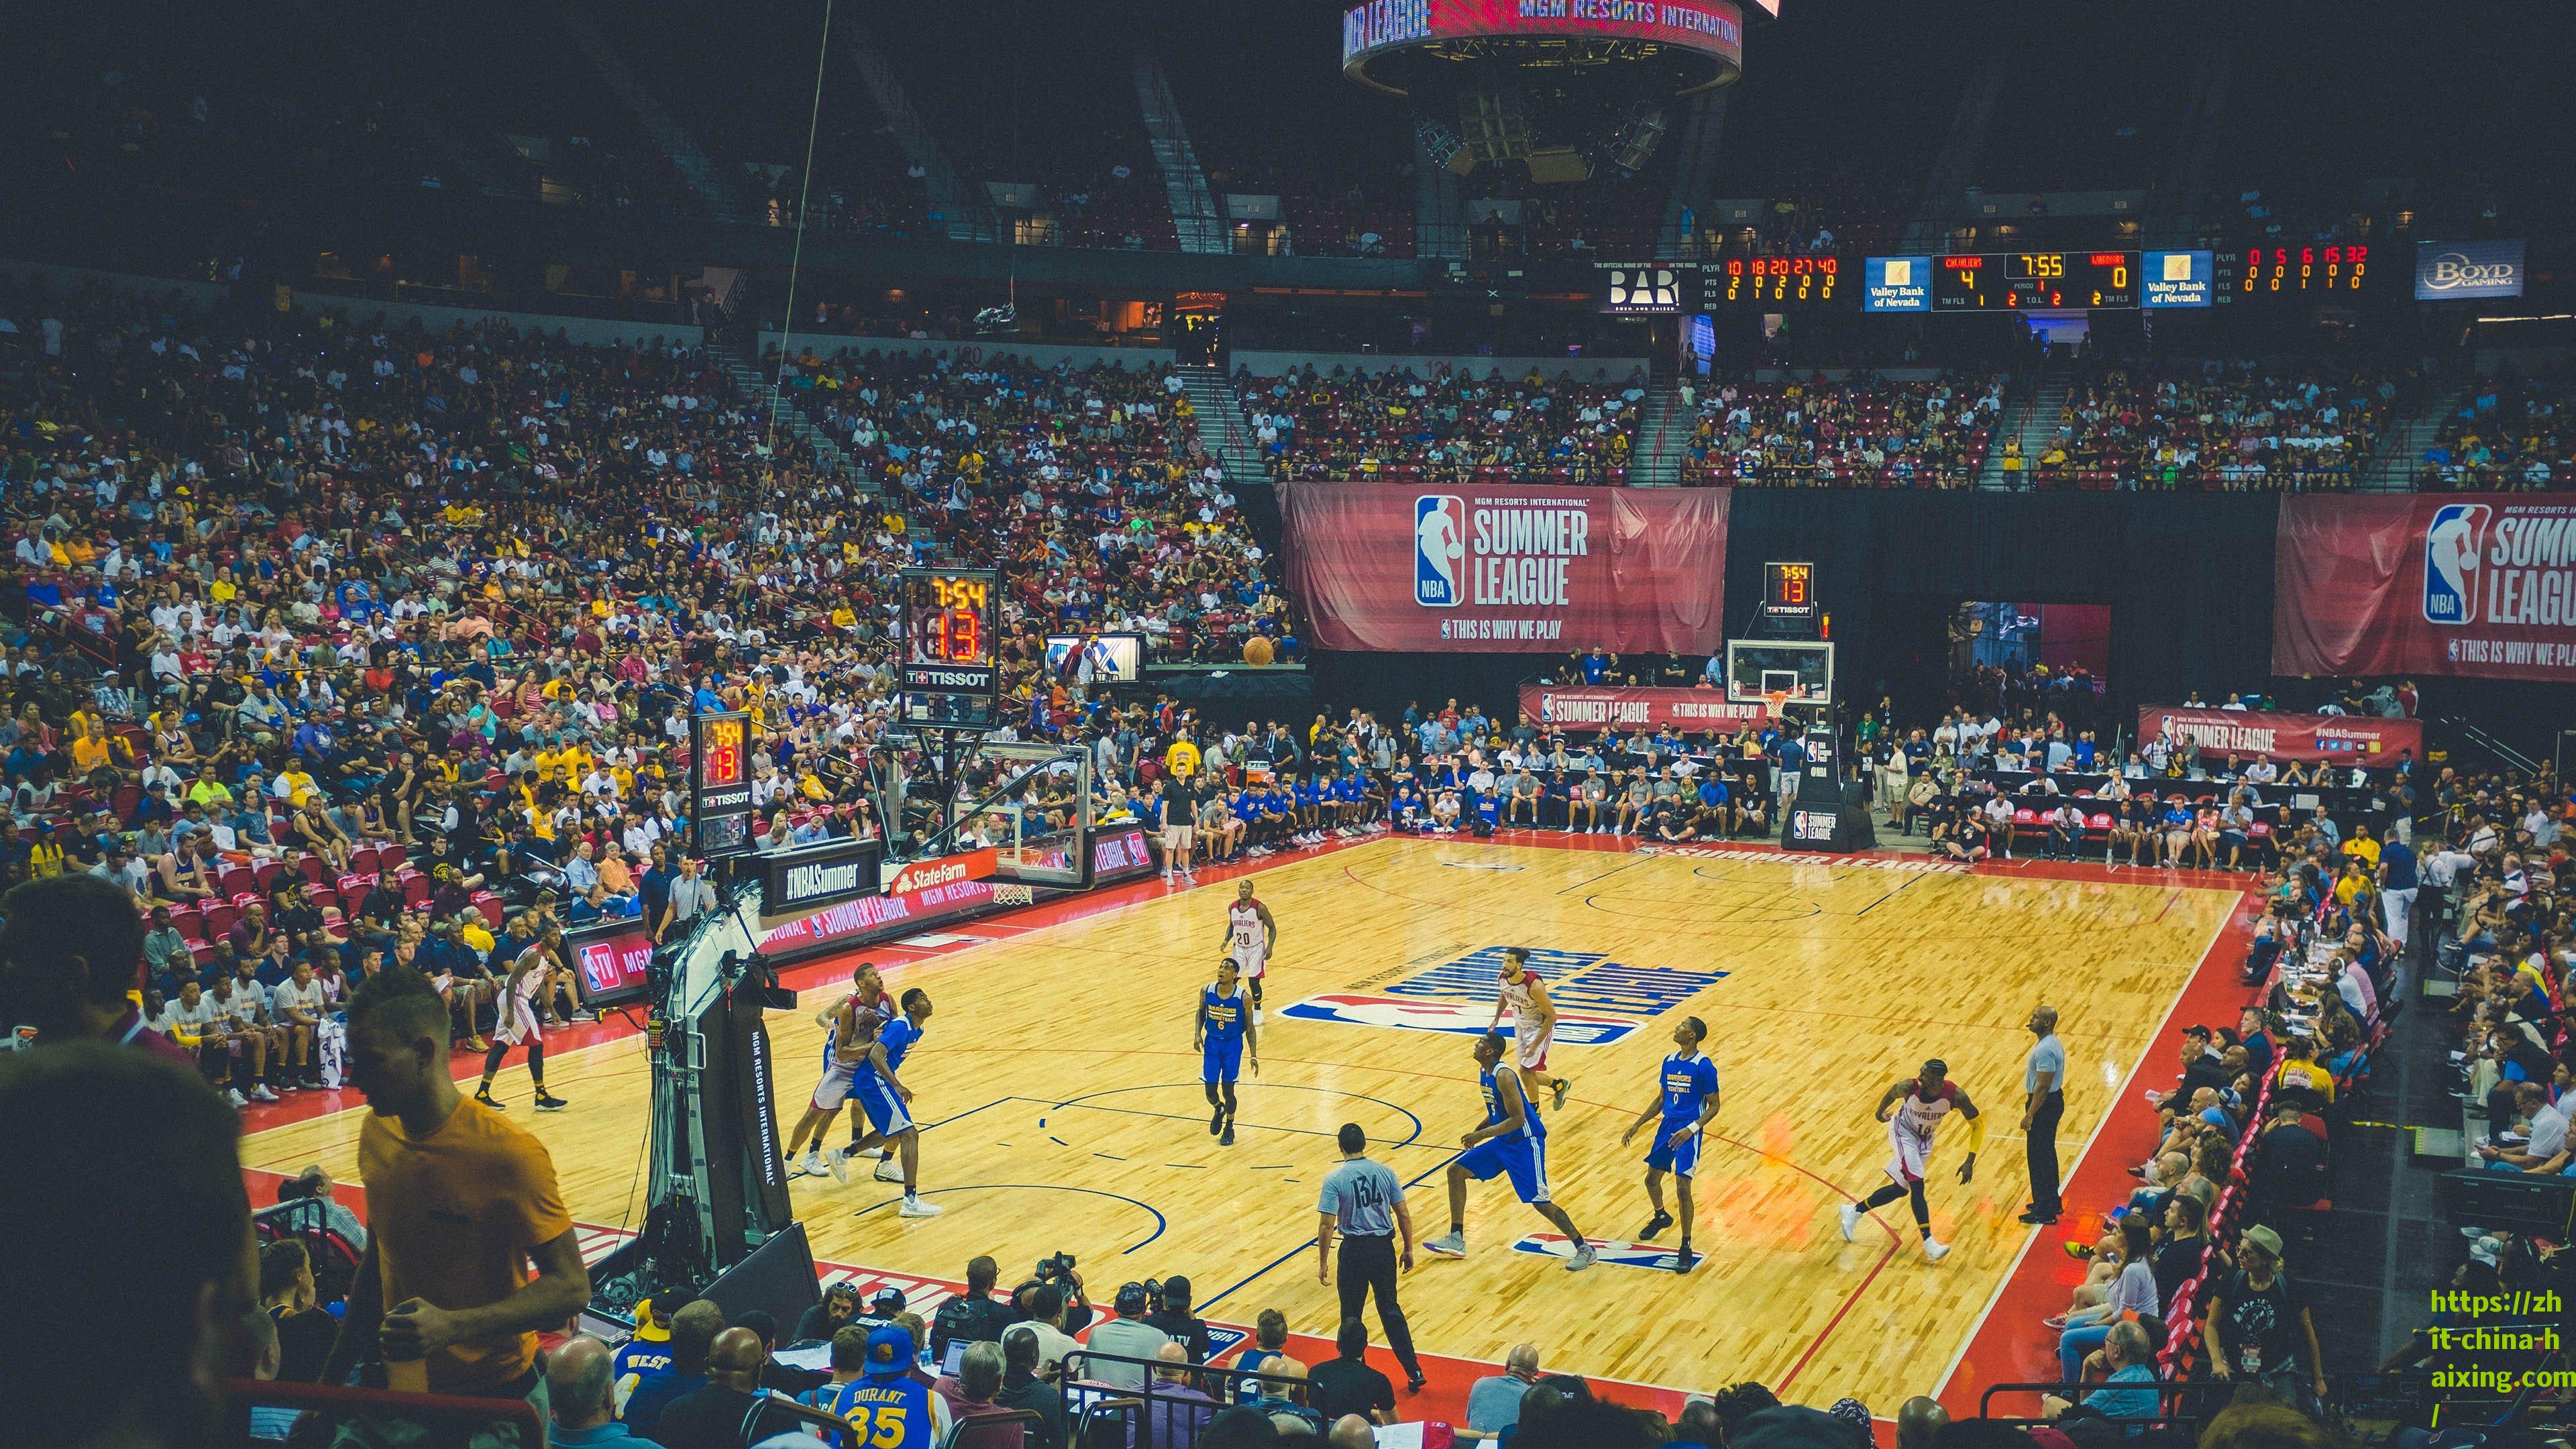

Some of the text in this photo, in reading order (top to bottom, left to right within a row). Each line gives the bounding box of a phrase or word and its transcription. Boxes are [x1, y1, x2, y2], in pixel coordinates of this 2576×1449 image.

[1573, 0, 1655, 23] RESORTS
[1945, 258, 1982, 268] CAVALIERS
[2216, 246, 2367, 265] PLYR 0 5 6 15 32
[1728, 261, 1742, 274] 10
[1753, 260, 1765, 274] 18
[1771, 260, 1788, 274] 20
[1794, 260, 1812, 274] 27
[1819, 259, 1836, 274] 40
[1962, 256, 2127, 289] 4 7:55 0
[2249, 266, 2257, 278] 0
[2276, 265, 2284, 278] 0
[2302, 264, 2310, 277] 0
[2329, 264, 2337, 276] 0
[2356, 263, 2365, 276] 0
[2435, 262, 2514, 281] BOYD
[1732, 276, 1739, 288] 2
[1756, 276, 1763, 288] 0
[1779, 276, 1786, 287] 2
[1803, 275, 1810, 287] 0
[1827, 274, 1834, 286] 0
[2148, 281, 2206, 293] Valley Bank
[2245, 279, 2253, 291] 0
[2351, 276, 2359, 288] 0
[2462, 278, 2513, 286] GAMING
[1728, 288, 1735, 300] 0
[1775, 287, 1783, 299] 0
[1799, 287, 1806, 299] 0
[1823, 286, 1830, 299] 0
[1871, 286, 1924, 298] Valley Bank
[2008, 294, 2017, 306] 2
[2053, 293, 2061, 305] 2
[2092, 291, 2101, 305] 2
[2152, 292, 2201, 303] of Nevada
[1874, 297, 1920, 307] of Nevada
[1474, 498, 1492, 506] MGM
[2528, 506, 2567, 515] RESORTS
[1474, 509, 1588, 556] SUMMER
[1475, 557, 1569, 605] LEAGUE
[1781, 566, 1808, 580] 7:54
[932, 579, 985, 609] 7:54
[1421, 580, 1445, 598] NBA
[1784, 581, 1803, 602] 13
[2430, 594, 2455, 614] NBA
[938, 612, 979, 661] 13
[1452, 619, 1562, 639] THIS IS WHY WE PLAY
[2461, 639, 2489, 662] THIS
[2491, 641, 2504, 663] IS
[2506, 641, 2534, 664] WHY
[2536, 643, 2555, 665] WE
[932, 672, 989, 688] TISSOT
[1556, 700, 1606, 722] SUMMER
[1680, 704, 1758, 719] THIS IS WHY WE PLAY
[2231, 727, 2275, 752] LEAGUE
[2316, 728, 2380, 740] #NBASummer
[718, 750, 735, 780] 13
[1811, 767, 1827, 777] @NBA
[716, 792, 750, 806] TISSOT
[1809, 815, 1836, 829] SUMMER
[1808, 828, 1831, 840] LEAGUE
[1099, 839, 1128, 871] LEAGUE
[1134, 839, 1146, 858] TV
[1666, 848, 1976, 873] SUMMER LEAGUE
[787, 863, 859, 900] #NBASummer
[823, 898, 873, 934] SUMMER
[872, 896, 910, 924] LEAGUE
[920, 888, 945, 906] MGM
[945, 880, 987, 901] RESORTS
[1236, 932, 1249, 945] 20
[595, 953, 614, 980] TV
[1208, 1004, 1236, 1014] WARRIORS
[1218, 1020, 1225, 1030] 6
[752, 1031, 774, 1183] MGM RESORTS INTERNATIONAL
[1673, 1093, 1678, 1105] 0
[1352, 1175, 1383, 1209] 134
[1177, 1336, 1190, 1346] TV
[627, 1354, 672, 1371] WEST
[853, 1387, 907, 1404] DURANT
[843, 1407, 907, 1449] 35
